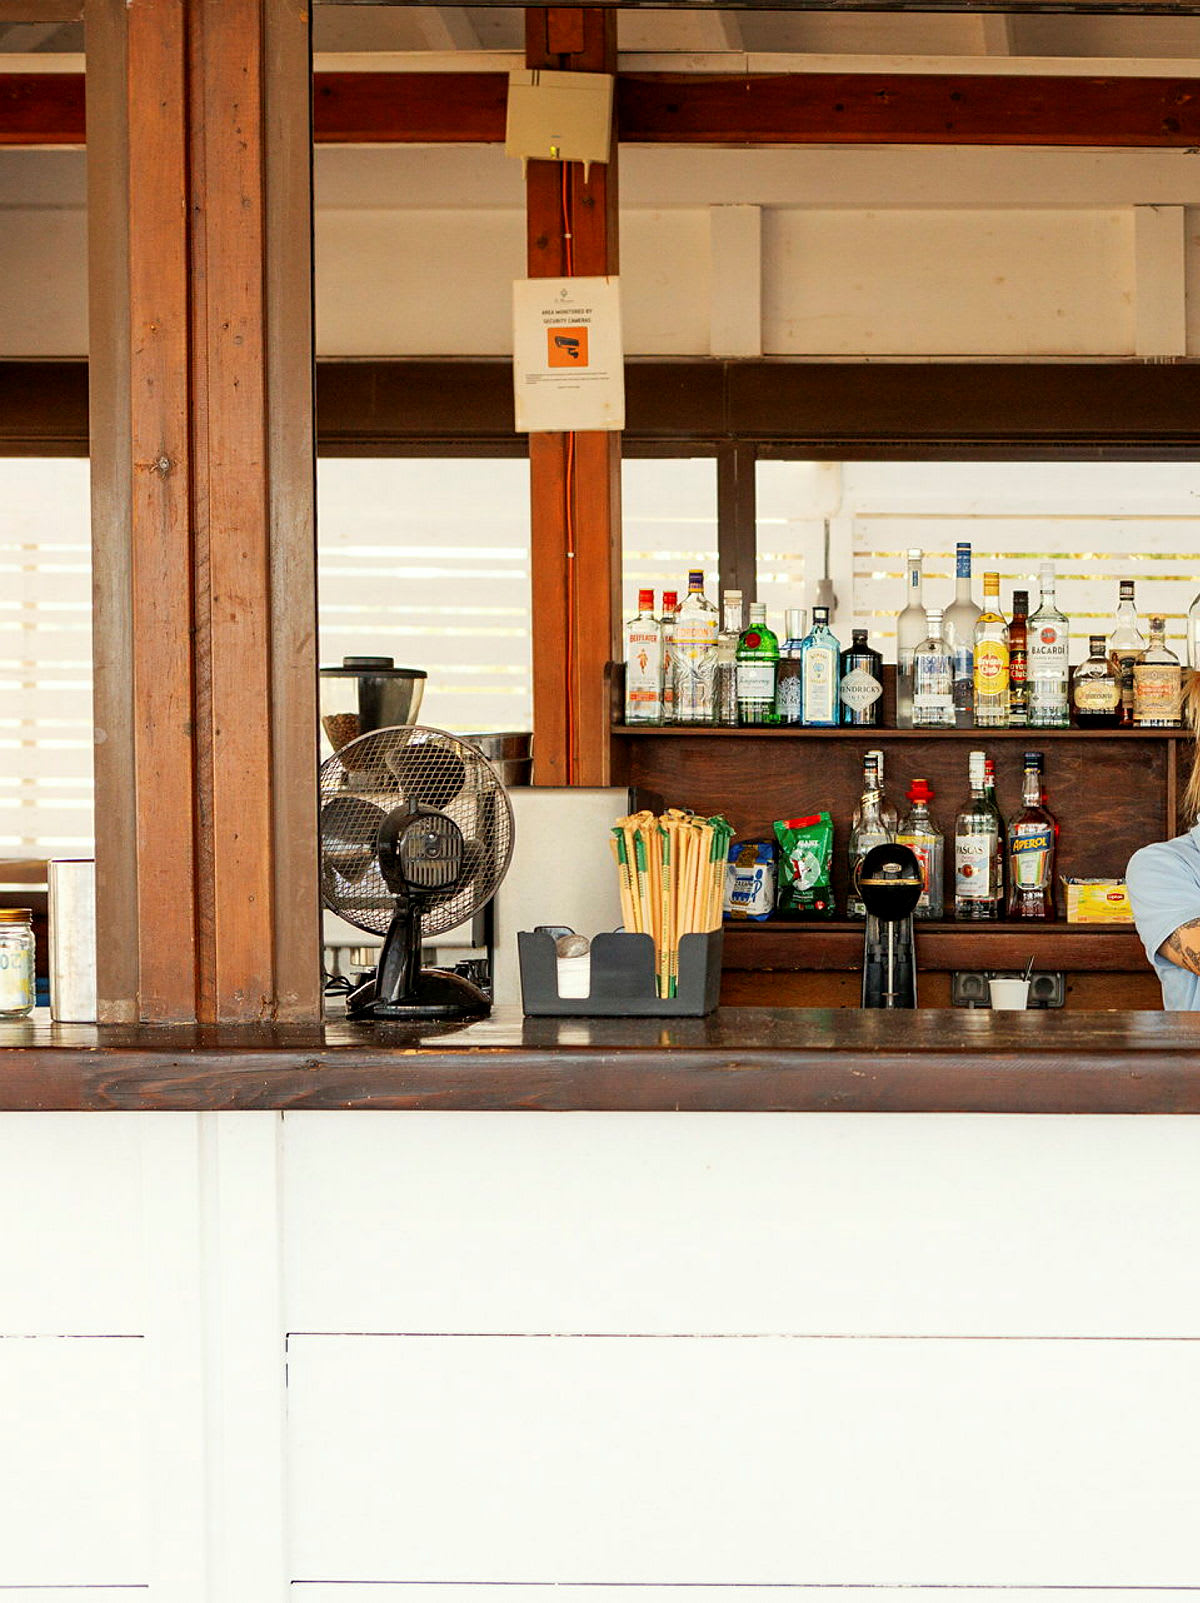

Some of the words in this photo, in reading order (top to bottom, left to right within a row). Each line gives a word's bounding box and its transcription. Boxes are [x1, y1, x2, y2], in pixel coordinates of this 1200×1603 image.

[629, 634, 658, 643] BEEFEATER
[1031, 644, 1065, 655] BACARDÍ
[840, 685, 880, 694] ENDRICK'S
[1013, 837, 1048, 852] APEROL
